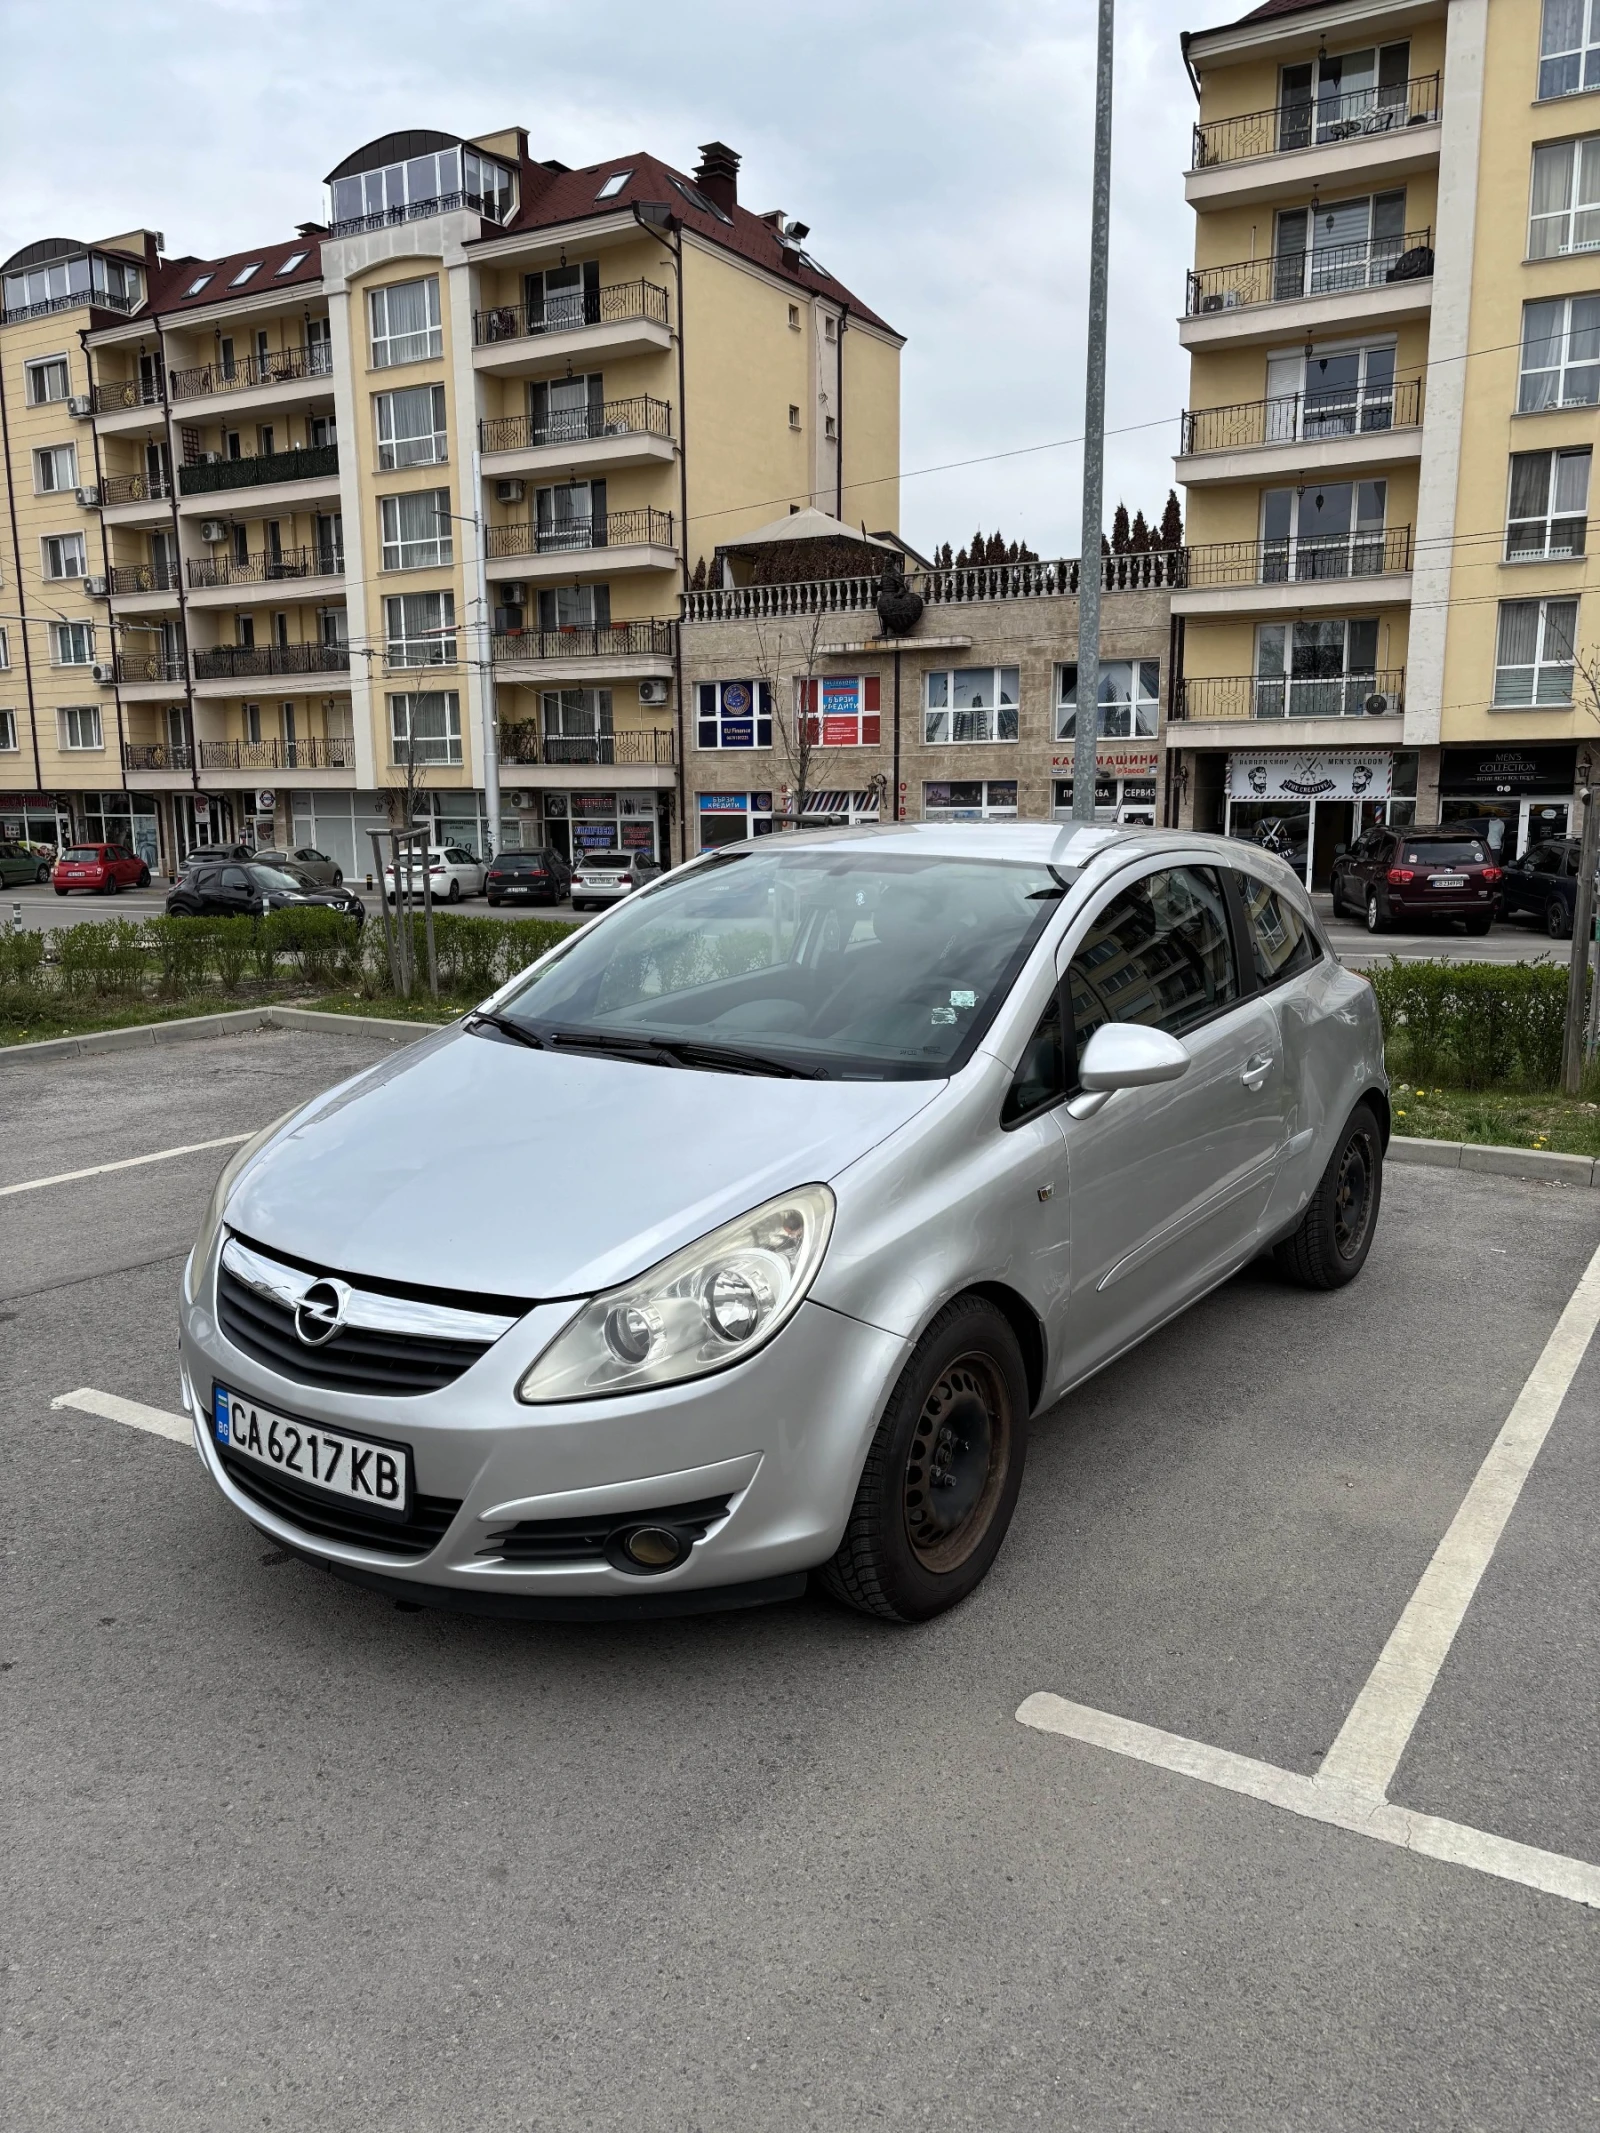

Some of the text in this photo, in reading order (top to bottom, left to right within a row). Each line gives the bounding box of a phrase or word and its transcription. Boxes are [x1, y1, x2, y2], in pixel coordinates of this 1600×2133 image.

[823, 703, 859, 711] КРЕДИТИ
[1495, 752, 1522, 762] MEN'S
[1479, 763, 1536, 773] COLLECTION
[1124, 788, 1156, 797] СЕРВИЗ
[1287, 782, 1330, 794] THE CREATIVE
[707, 801, 740, 809] КРЕДИТИ
[218, 1420, 229, 1436] BG
